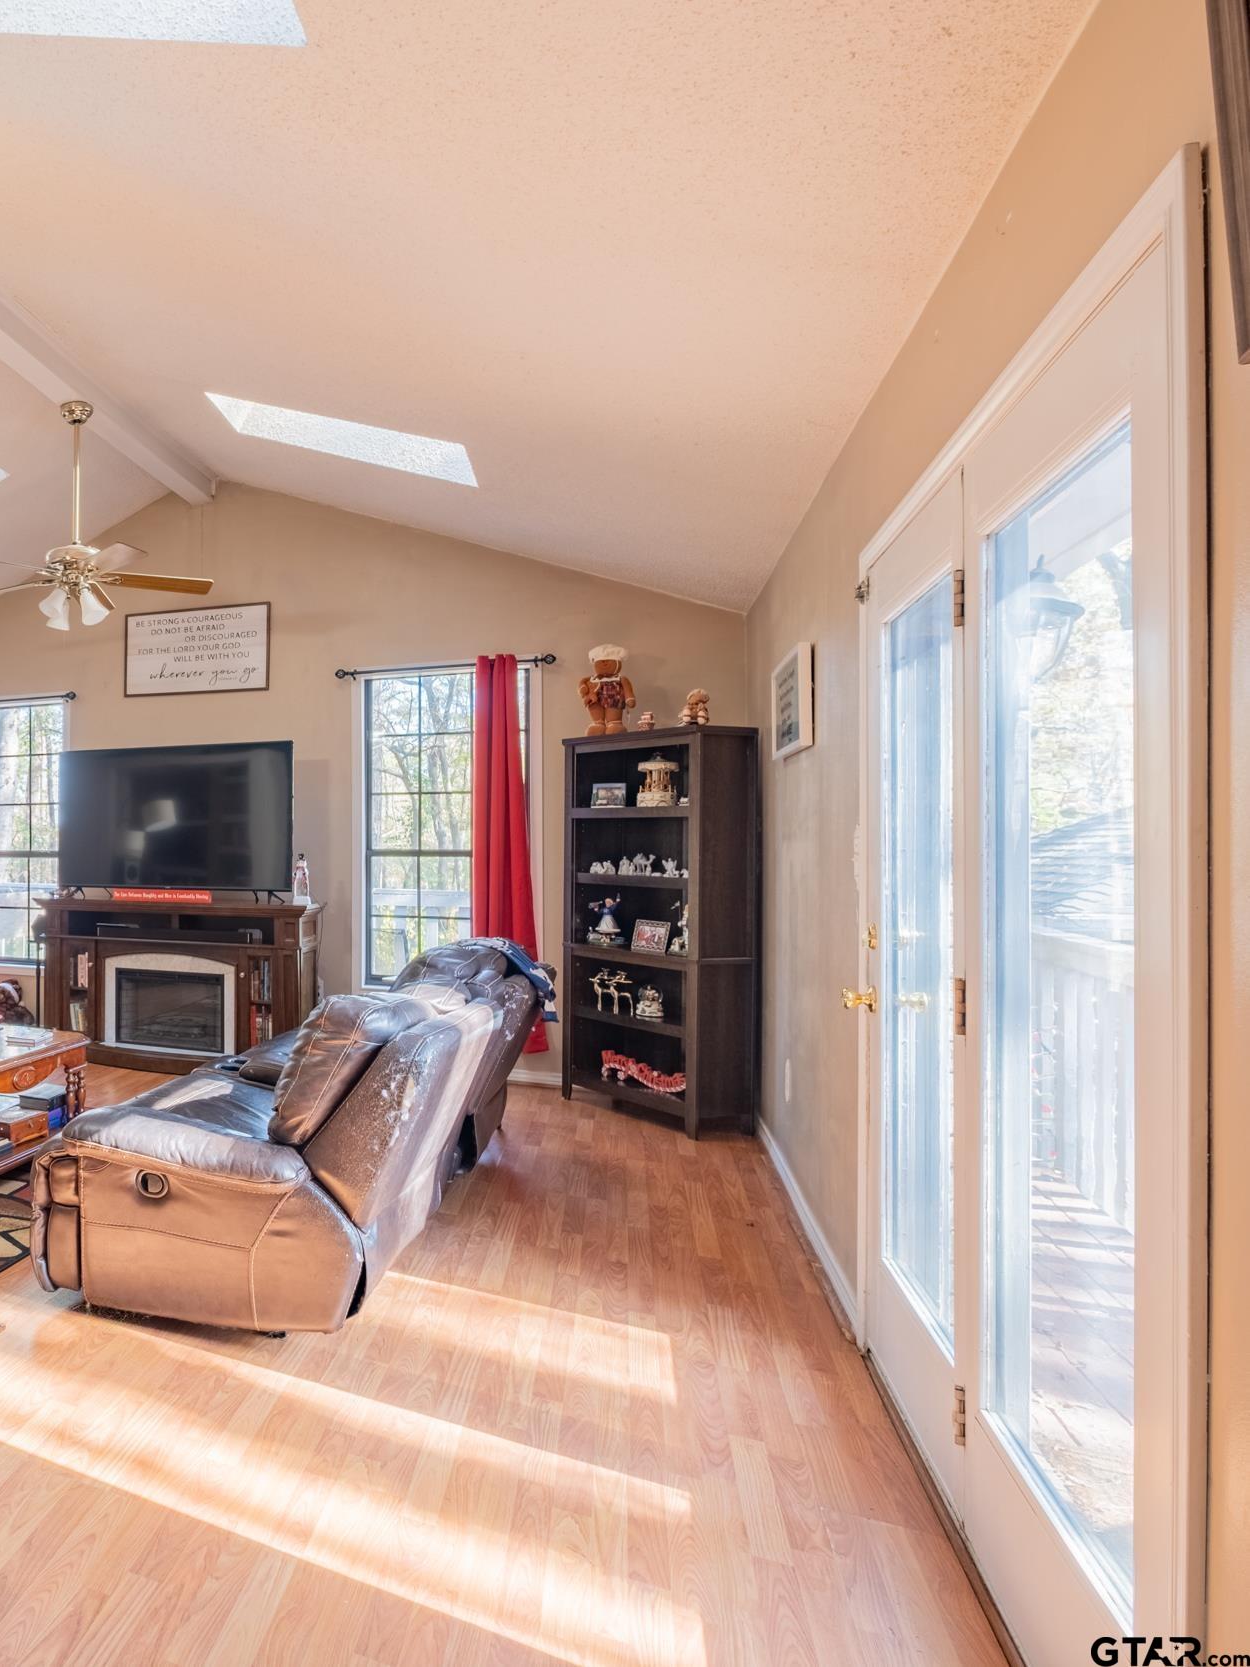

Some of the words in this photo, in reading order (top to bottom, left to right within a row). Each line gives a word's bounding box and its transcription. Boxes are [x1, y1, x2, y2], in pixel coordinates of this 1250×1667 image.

[136, 619, 145, 627] BE
[147, 617, 179, 627] STRONG
[187, 612, 243, 624] COURAGEOUS
[151, 628, 163, 636] DO
[184, 625, 194, 633] BE
[196, 624, 225, 632] AFRAID
[199, 631, 257, 641] DISCOURAGED
[197, 643, 220, 651] YOUR
[222, 642, 241, 650] GOD
[150, 663, 204, 680] wherever
[209, 669, 237, 686] you
[239, 666, 258, 684] go
[601, 1050, 635, 1072] Merry
[636, 1063, 686, 1089] Christmas
